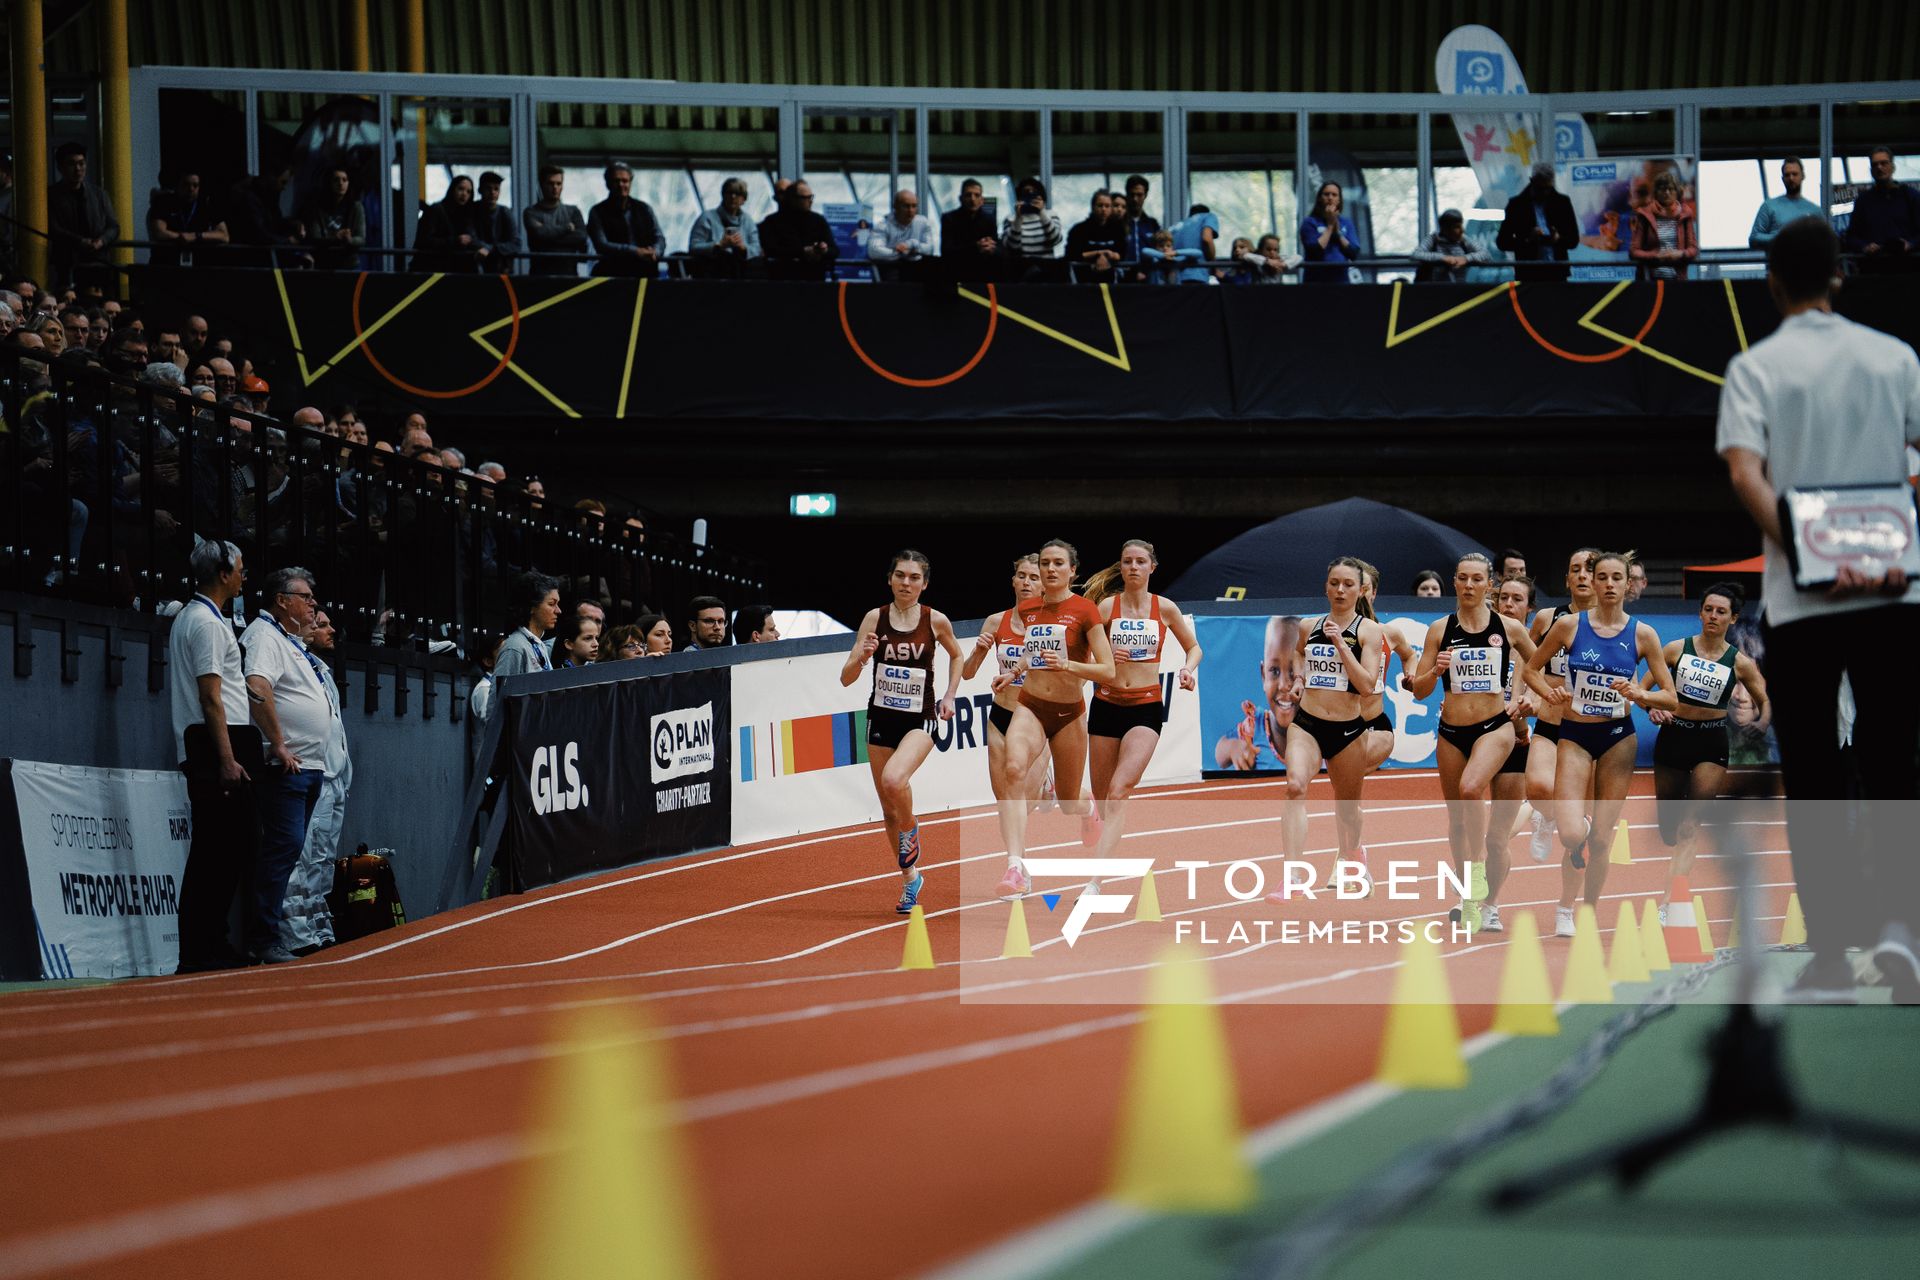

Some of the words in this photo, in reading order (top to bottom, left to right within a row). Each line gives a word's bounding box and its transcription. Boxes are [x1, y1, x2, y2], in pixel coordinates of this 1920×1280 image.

[884, 642, 925, 661] ASV
[1026, 640, 1061, 652] GRANZ
[885, 668, 910, 680] GLS
[1308, 660, 1344, 673] TROST
[878, 680, 921, 695] COUTELLIER
[1580, 687, 1620, 703] MEISL
[676, 719, 710, 751] PLAN
[679, 752, 712, 766] INTERNATIONAL
[656, 782, 711, 814] CHARITY-PARTNER
[51, 813, 133, 850] SPORTERLEBNIS
[169, 818, 190, 840] RUHR
[60, 872, 141, 917] METROPOLE
[141, 874, 179, 916] RUHR
